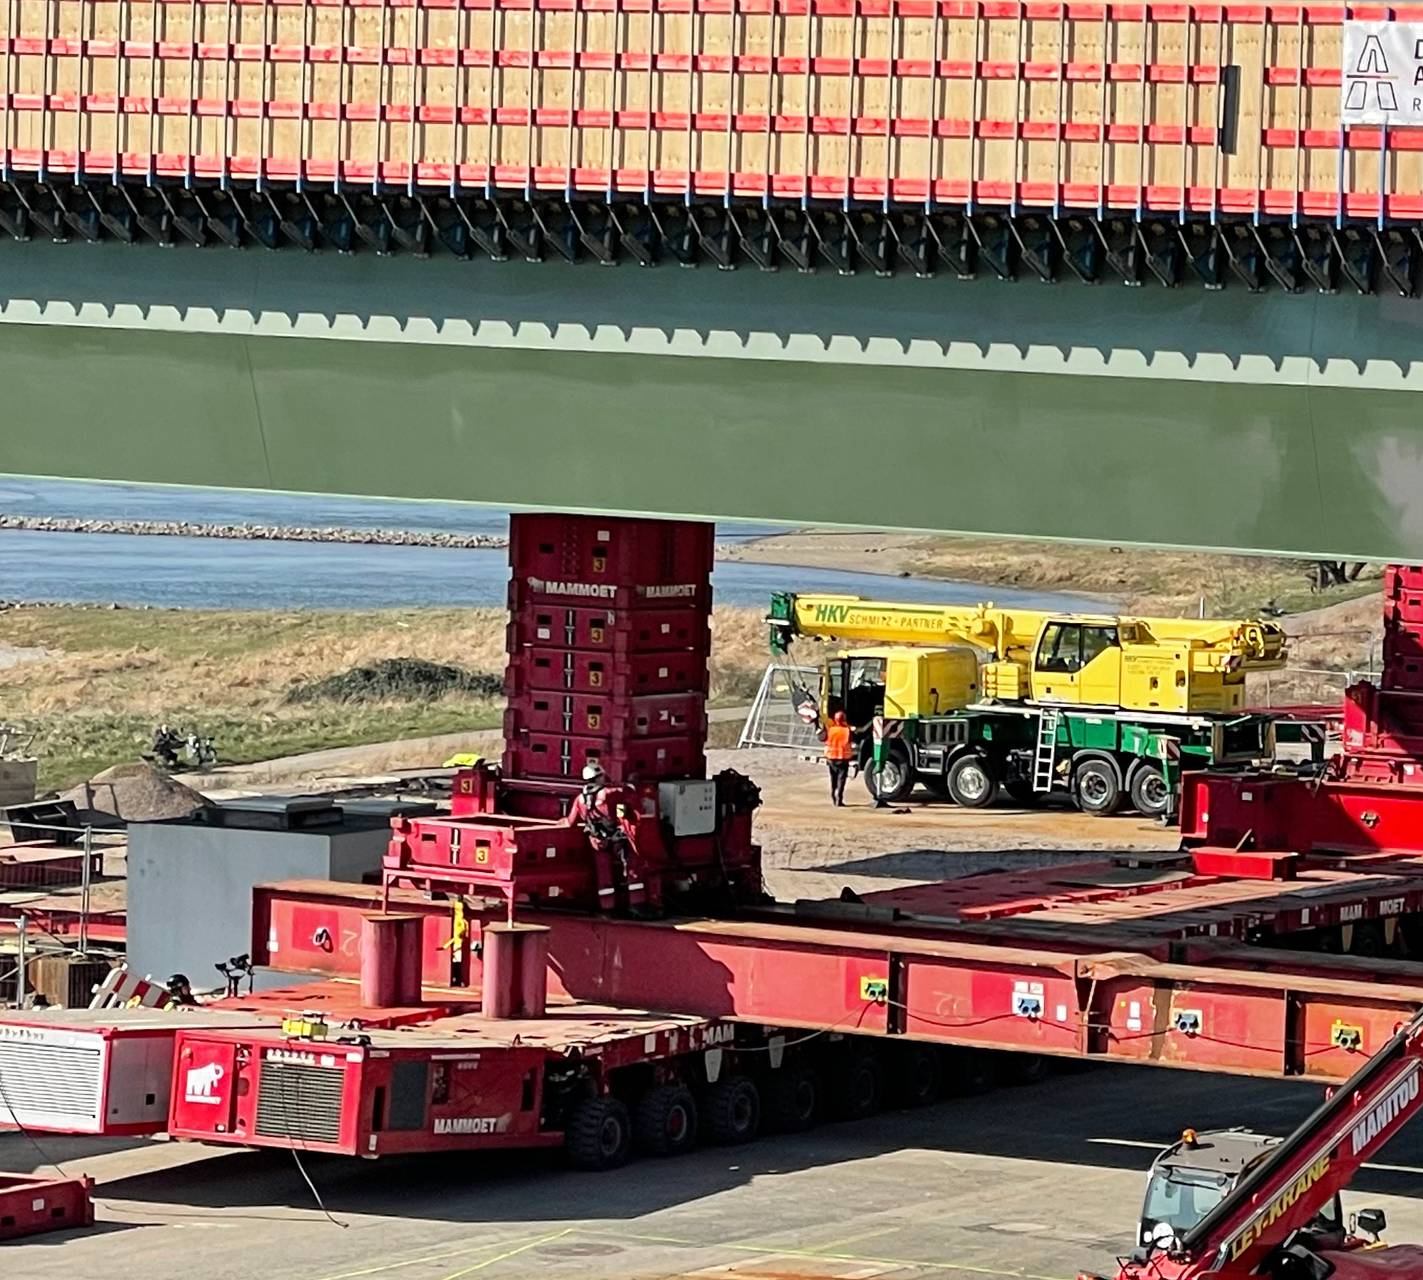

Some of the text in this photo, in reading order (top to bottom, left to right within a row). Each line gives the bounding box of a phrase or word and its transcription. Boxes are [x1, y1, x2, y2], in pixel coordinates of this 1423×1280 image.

[546, 581, 618, 598] MAMMOET
[816, 604, 850, 623] HKV
[900, 617, 944, 629] PARTNER
[1380, 898, 1405, 915] MOET
[1352, 1071, 1420, 1156] MANITOU
[434, 1117, 497, 1134] MAMMOET
